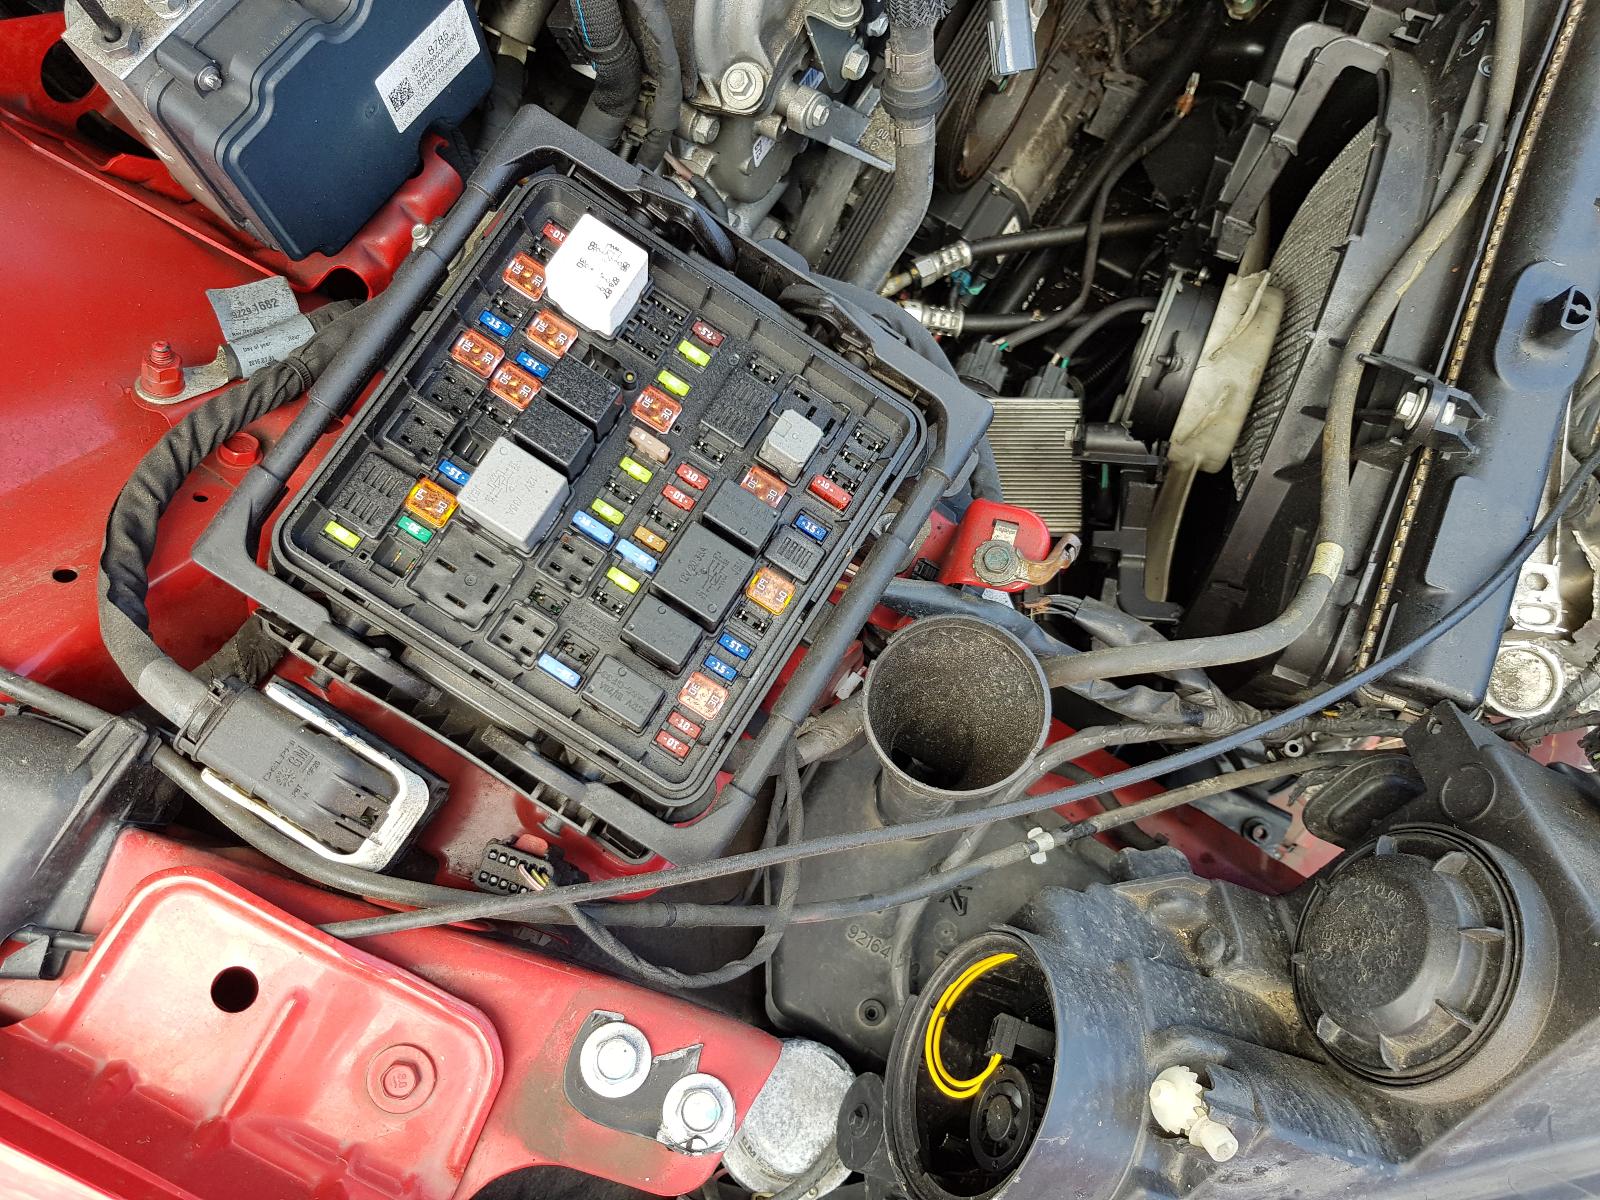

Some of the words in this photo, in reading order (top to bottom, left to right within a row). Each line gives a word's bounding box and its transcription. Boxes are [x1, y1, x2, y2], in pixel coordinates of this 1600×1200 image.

[427, 30, 449, 56] 8785
[512, 263, 525, 275] 30
[532, 274, 544, 287] 30
[535, 320, 549, 333] 30
[556, 332, 568, 345] 30
[461, 341, 474, 354] 30
[482, 352, 495, 365] 30
[499, 371, 512, 385] 30
[519, 384, 532, 397] 30
[641, 395, 654, 409] 30
[661, 407, 673, 421] 30
[686, 468, 699, 482] 10
[747, 477, 759, 490] 30
[820, 479, 830, 490] 10
[414, 488, 427, 500] 60
[767, 489, 778, 502] 30
[436, 500, 448, 514] 60
[804, 521, 817, 533] 15
[646, 534, 655, 543] 5
[757, 578, 769, 591] 60
[776, 591, 788, 603] 60
[713, 661, 726, 674] 15
[688, 683, 701, 697] 30
[707, 696, 720, 710] 30
[677, 719, 691, 732] 10
[666, 737, 680, 750] 10
[846, 924, 894, 962] 92164
